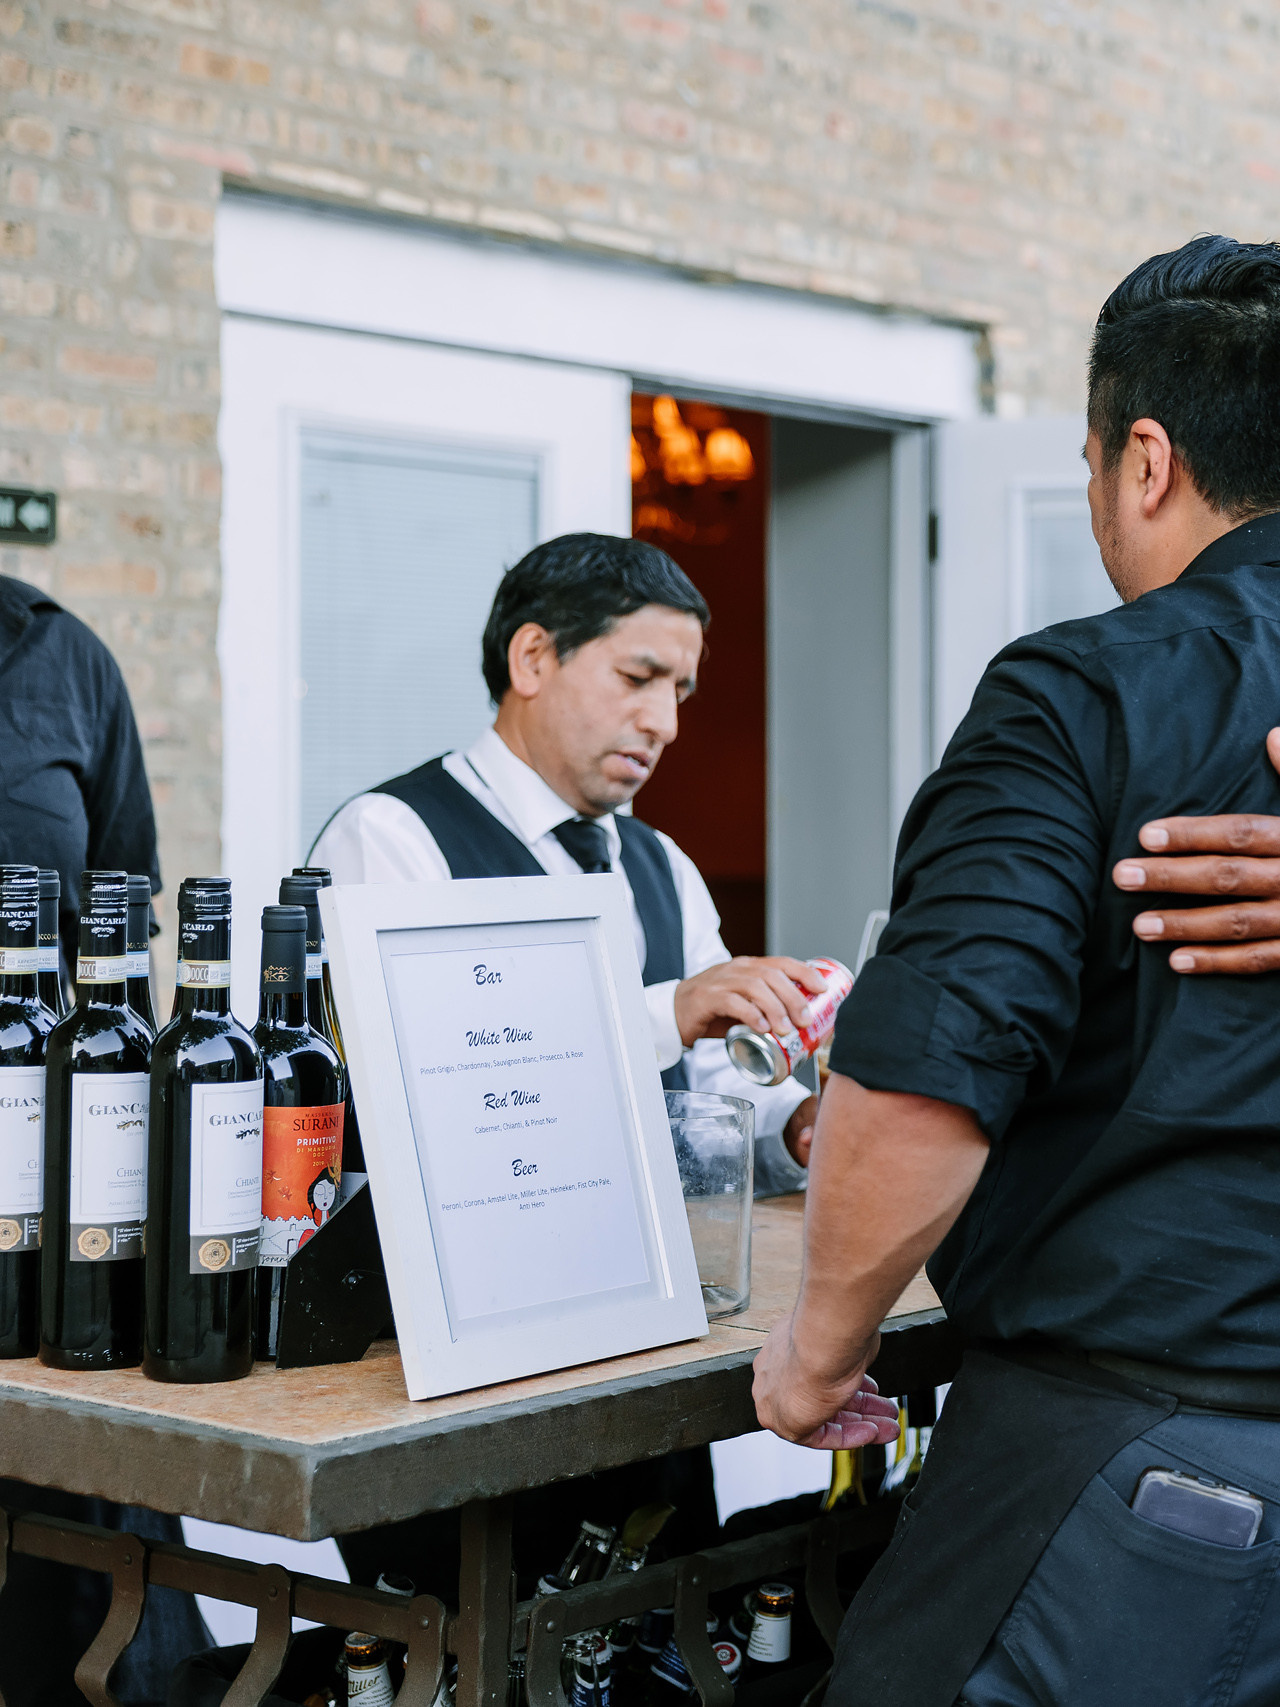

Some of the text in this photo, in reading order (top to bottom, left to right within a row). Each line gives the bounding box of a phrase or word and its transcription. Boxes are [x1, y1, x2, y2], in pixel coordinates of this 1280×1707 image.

[473, 963, 503, 986] Bar
[466, 1027, 534, 1047] White Wine
[420, 1067, 436, 1075] Pinot
[457, 1061, 493, 1071] Chardonnay,
[493, 1058, 521, 1067] Sauvignon
[522, 1056, 539, 1064] Blanc,
[540, 1053, 565, 1061] Prosecco,
[565, 1051, 570, 1059] &
[483, 1089, 541, 1111] Red Wine
[293, 1116, 339, 1132] SURANI
[474, 1124, 502, 1134] Cabernet,
[503, 1121, 524, 1130] Chianti,
[525, 1119, 530, 1127] &
[531, 1118, 545, 1126] Pinot
[296, 1135, 336, 1146] PRIMITIVO
[511, 1158, 538, 1177] Beer
[442, 1202, 464, 1211] Peroni,
[464, 1199, 486, 1208] Corona,
[487, 1194, 507, 1203] Amstel
[520, 1190, 536, 1198] Miller
[550, 1184, 577, 1193] Heineken,
[588, 1179, 598, 1187] City
